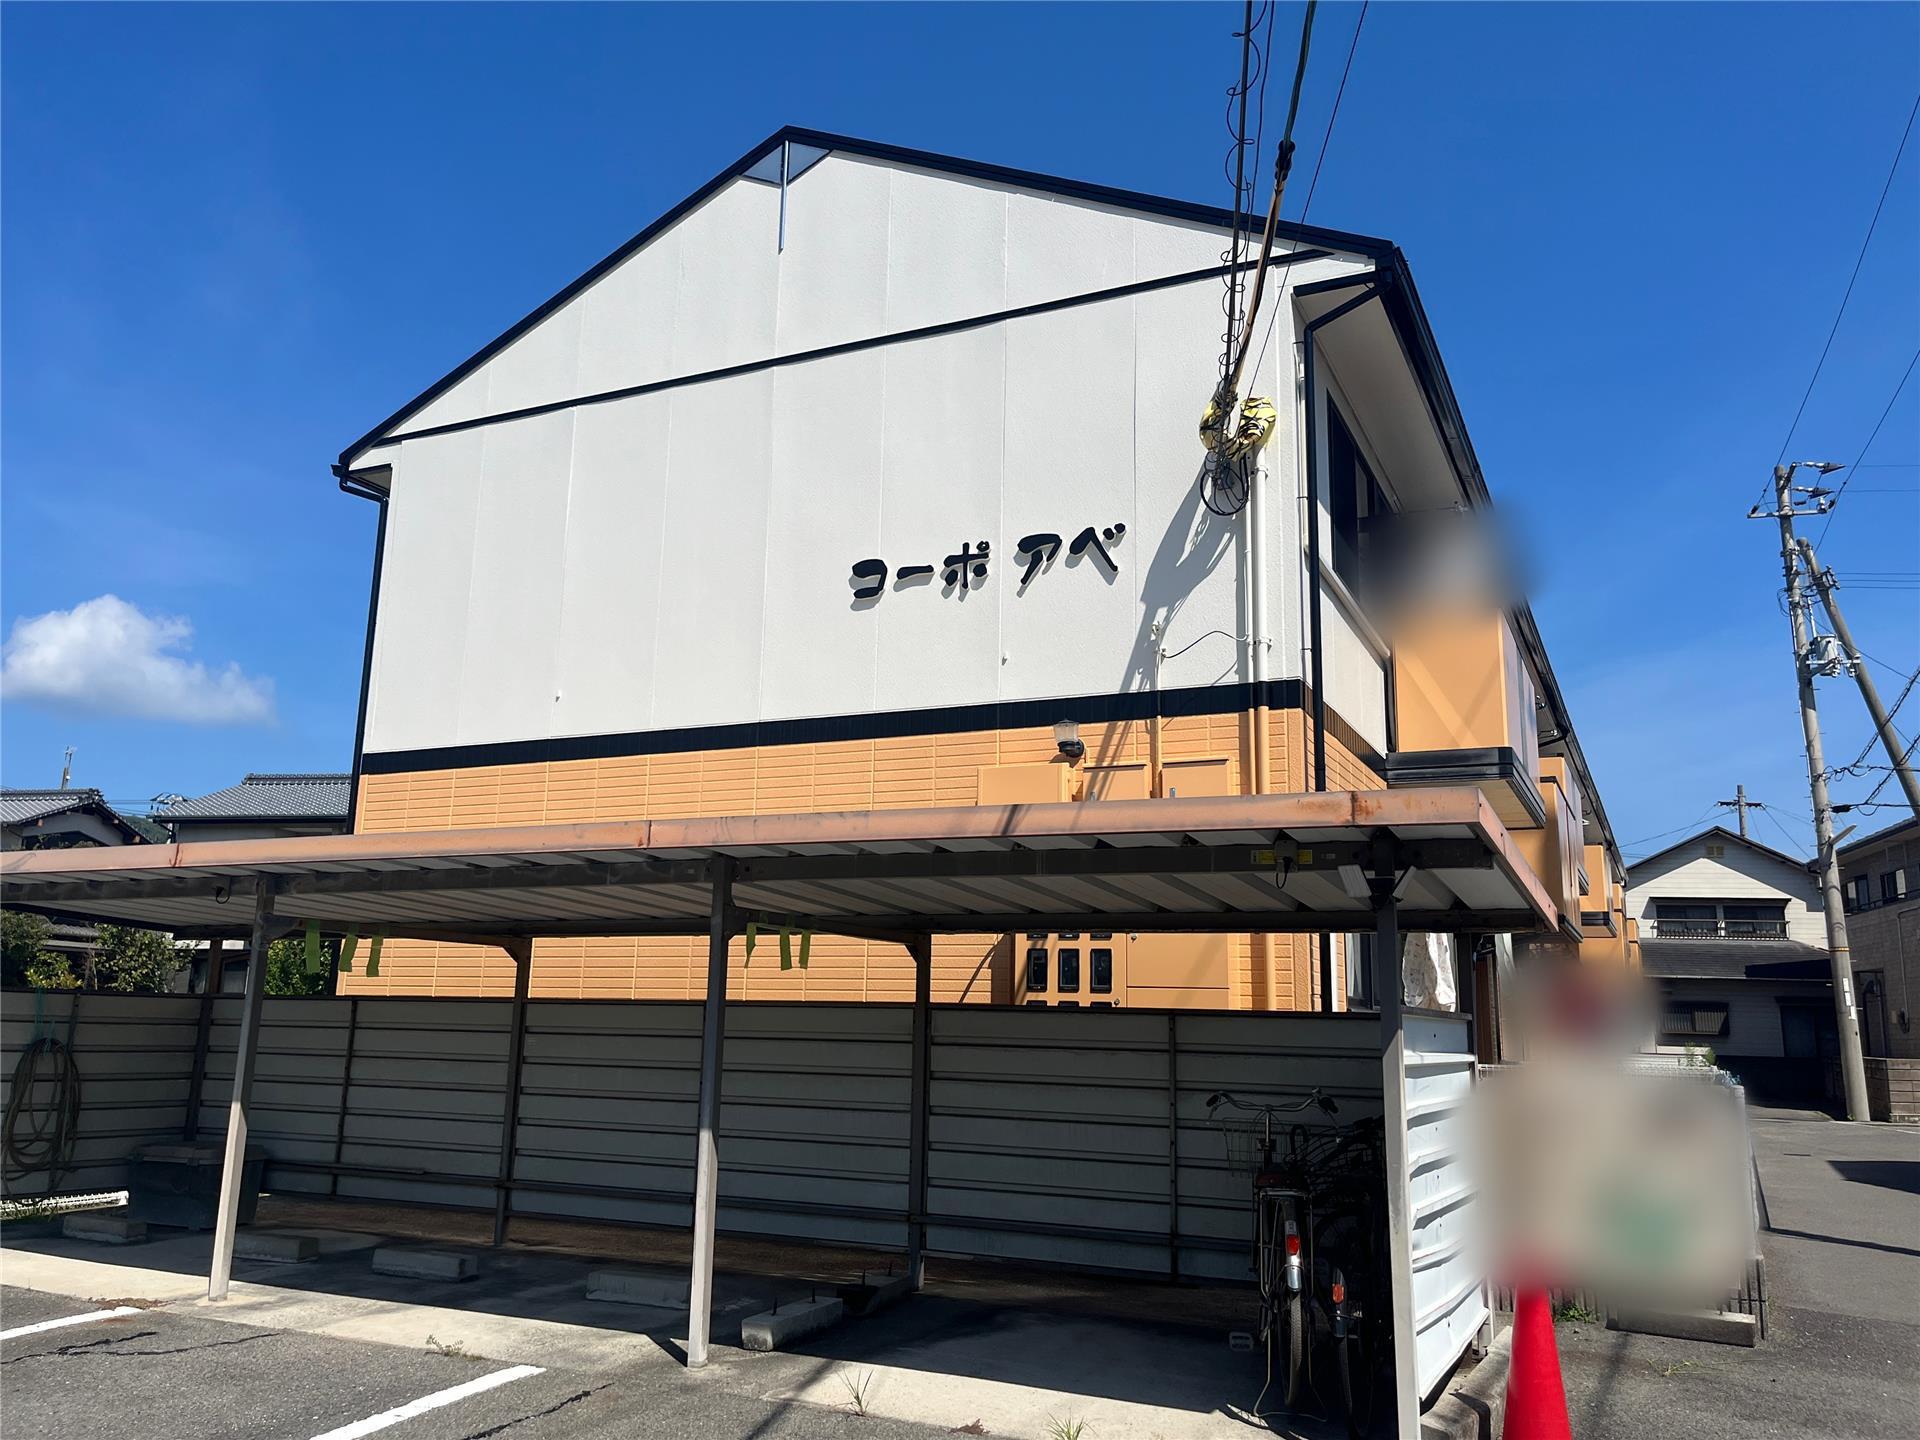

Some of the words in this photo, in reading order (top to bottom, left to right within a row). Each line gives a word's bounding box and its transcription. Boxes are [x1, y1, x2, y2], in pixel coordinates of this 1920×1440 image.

[851, 540, 990, 599] コーポ
[1017, 522, 1126, 586] アベ
